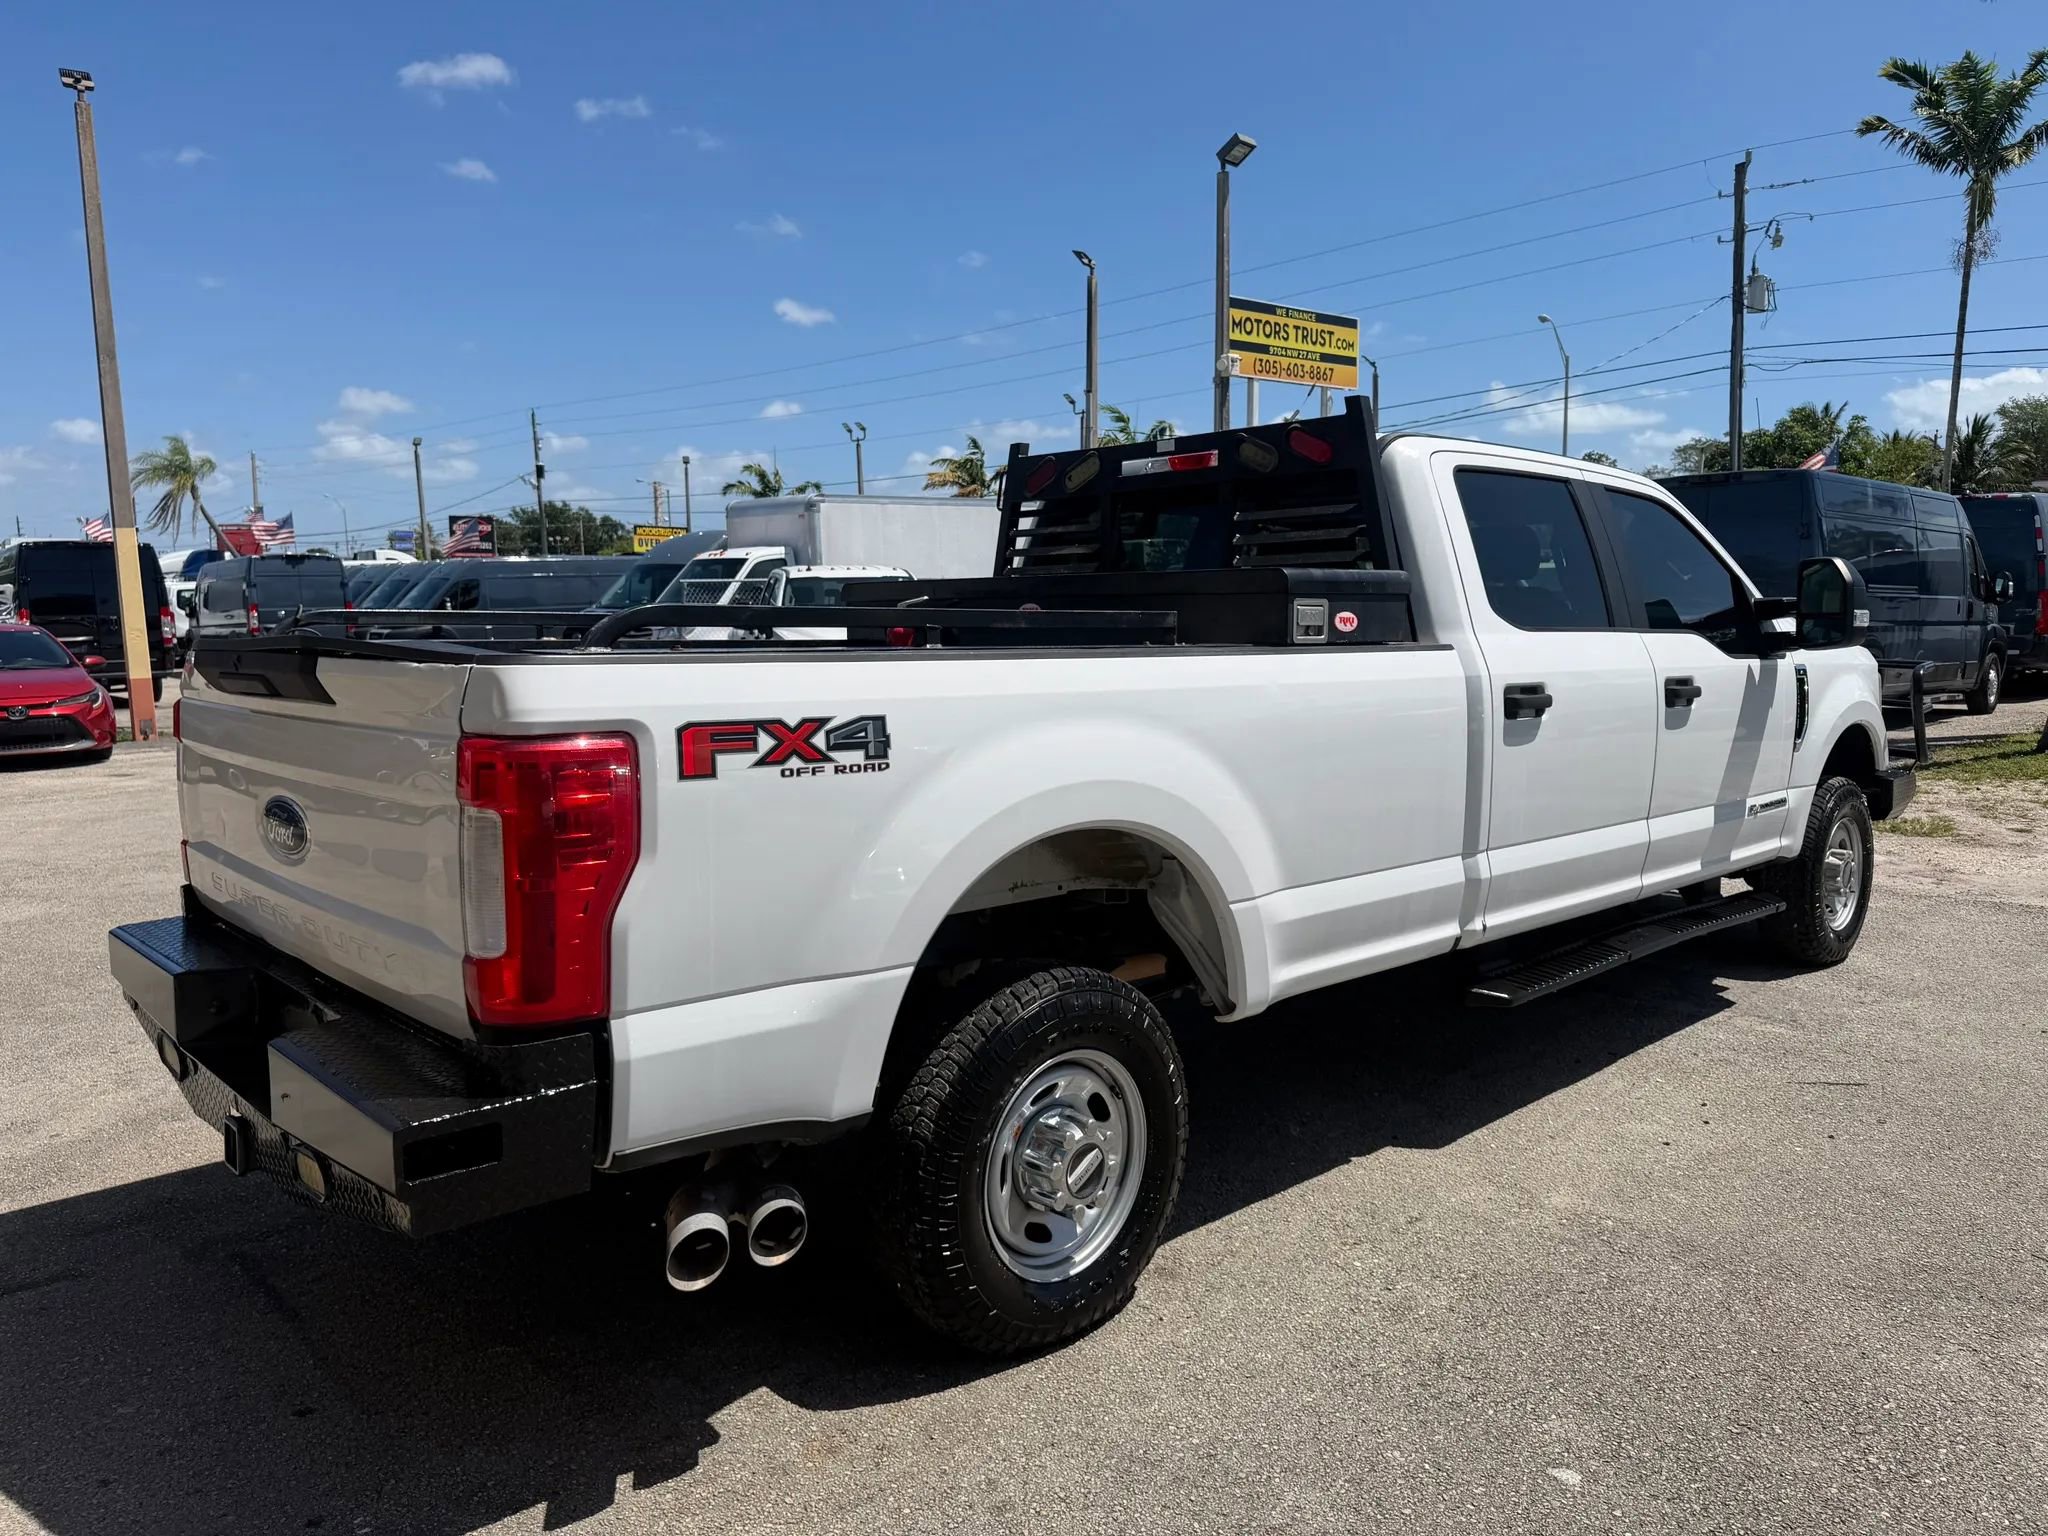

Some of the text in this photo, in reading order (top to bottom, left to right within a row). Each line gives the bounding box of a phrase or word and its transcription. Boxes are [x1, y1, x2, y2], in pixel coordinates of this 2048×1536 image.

[1275, 307, 1316, 322] WE FINANCE
[1231, 315, 1355, 352] MOTORS TRUST.COM
[1268, 346, 1321, 361] 9704 NW 27 AVE
[1253, 357, 1334, 382] (305)-603-8867
[675, 714, 891, 783] FX4
[780, 762, 891, 779] OFF ROAD
[267, 808, 296, 847] Ford
[211, 871, 399, 974] SUPER DUTY
